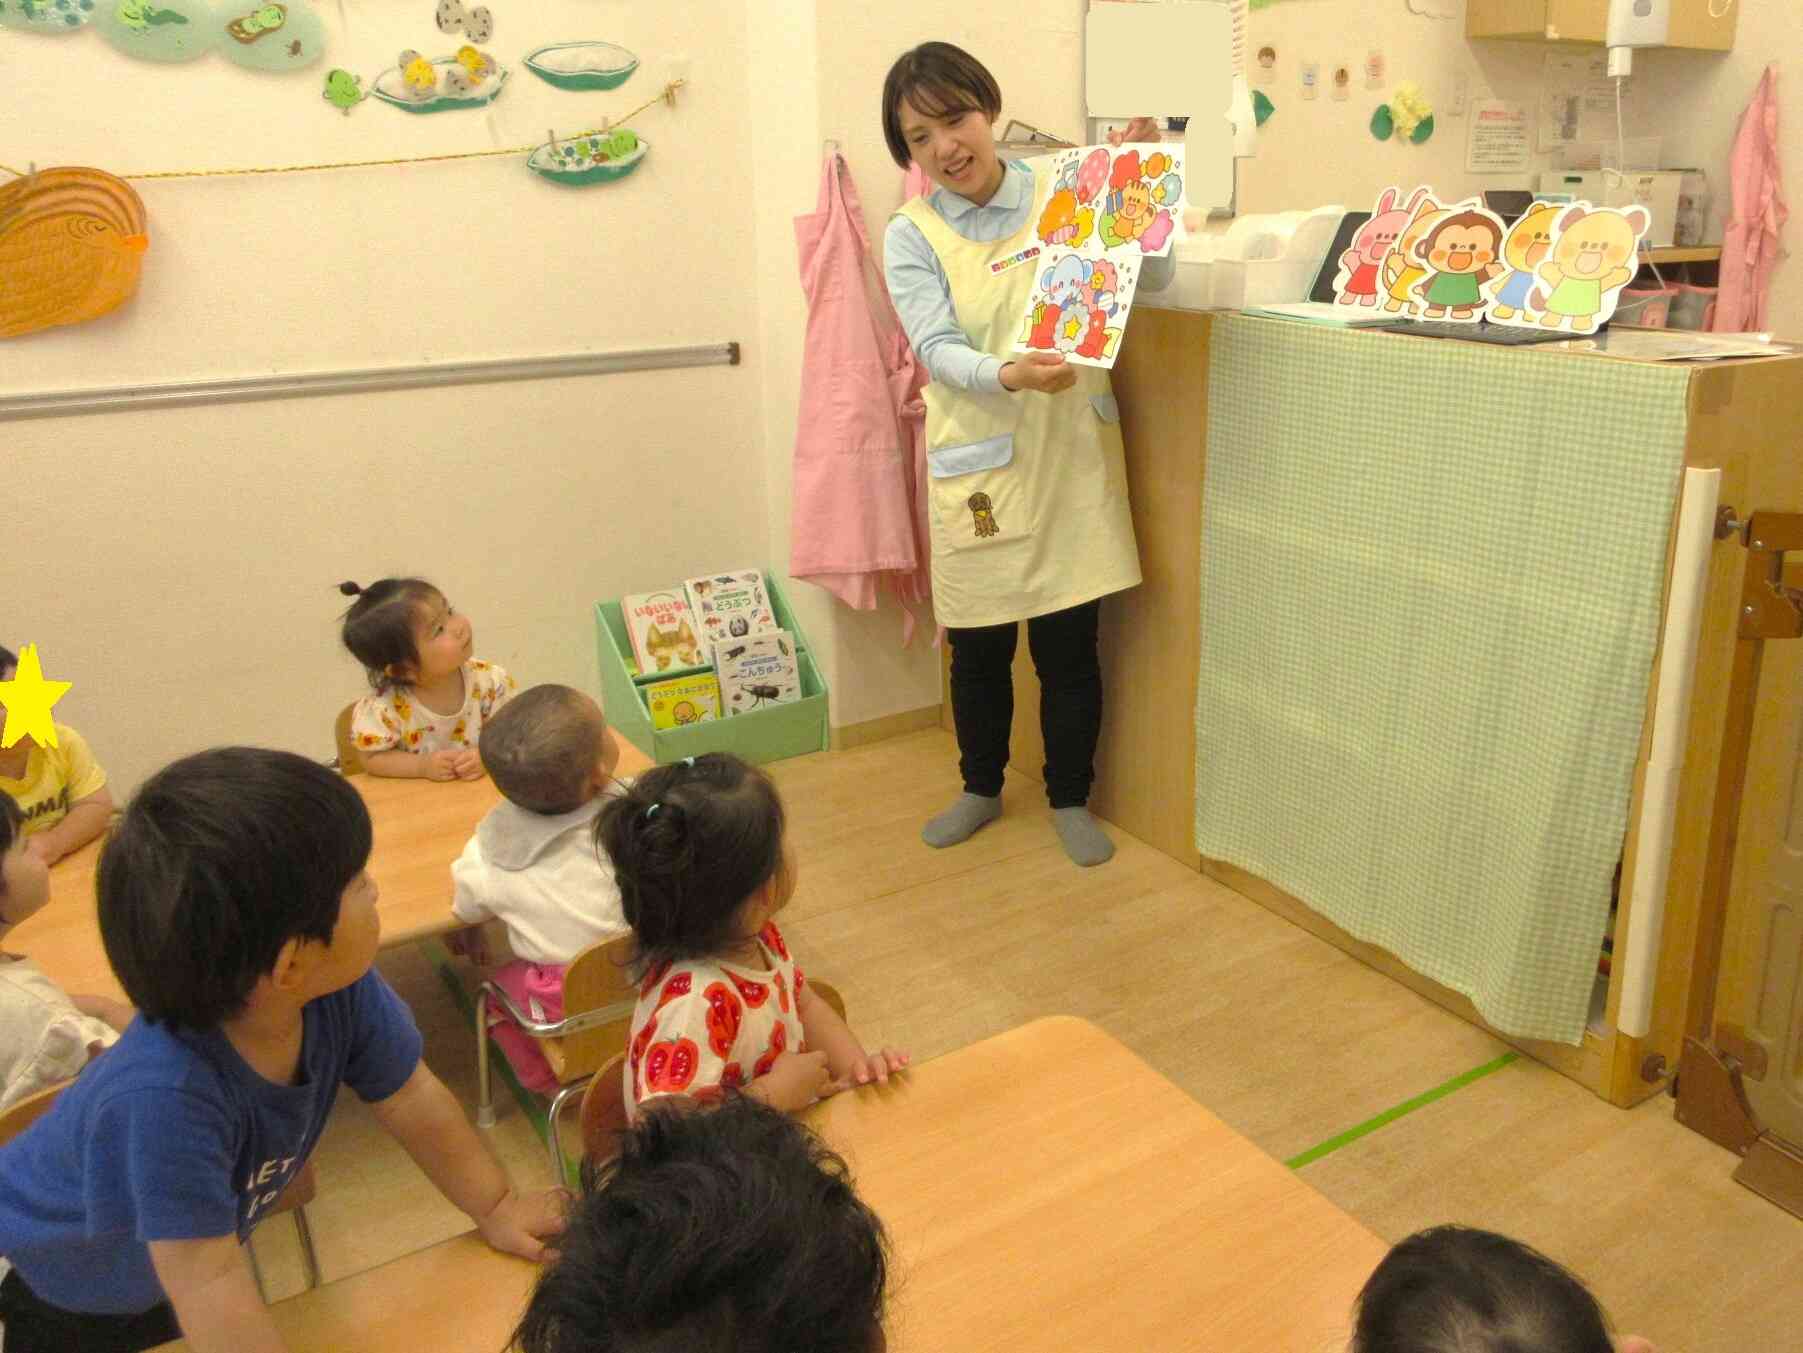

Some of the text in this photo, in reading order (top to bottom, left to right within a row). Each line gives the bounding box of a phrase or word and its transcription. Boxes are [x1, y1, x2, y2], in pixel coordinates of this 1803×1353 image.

[715, 598, 751, 611] どうぶつ
[739, 664, 783, 678] こんちゅう
